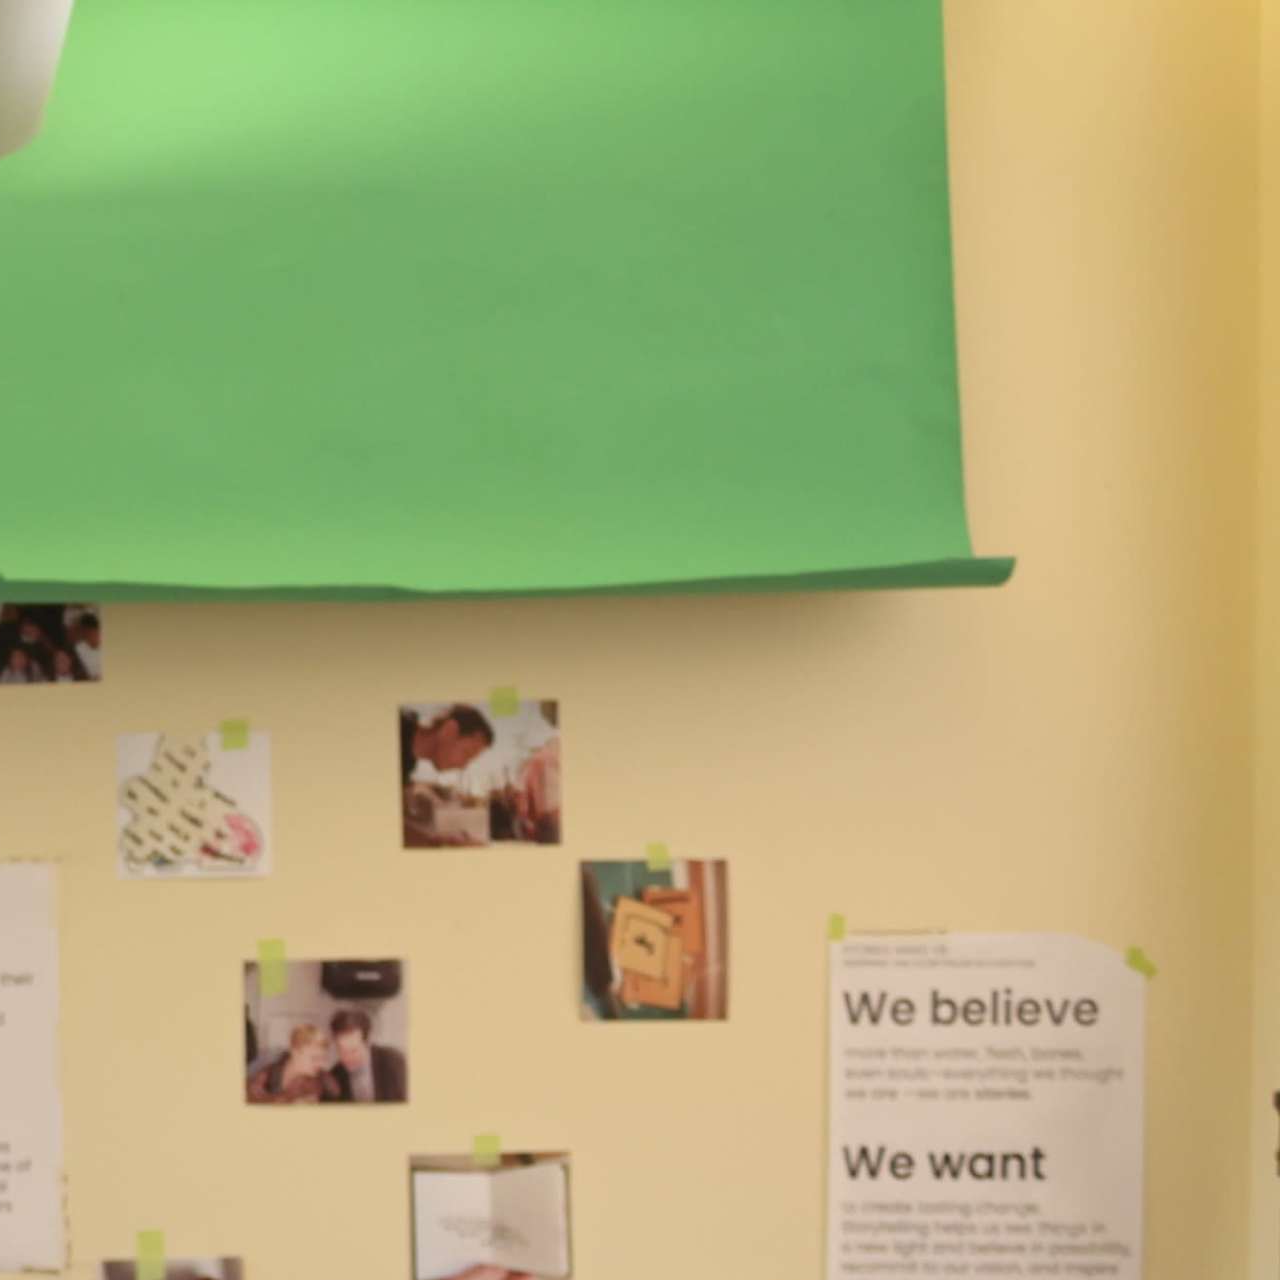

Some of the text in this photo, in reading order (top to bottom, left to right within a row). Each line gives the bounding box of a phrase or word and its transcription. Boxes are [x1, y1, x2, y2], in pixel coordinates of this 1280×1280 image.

[842, 987, 1099, 1026] We believe
[842, 1145, 1047, 1181] We want
